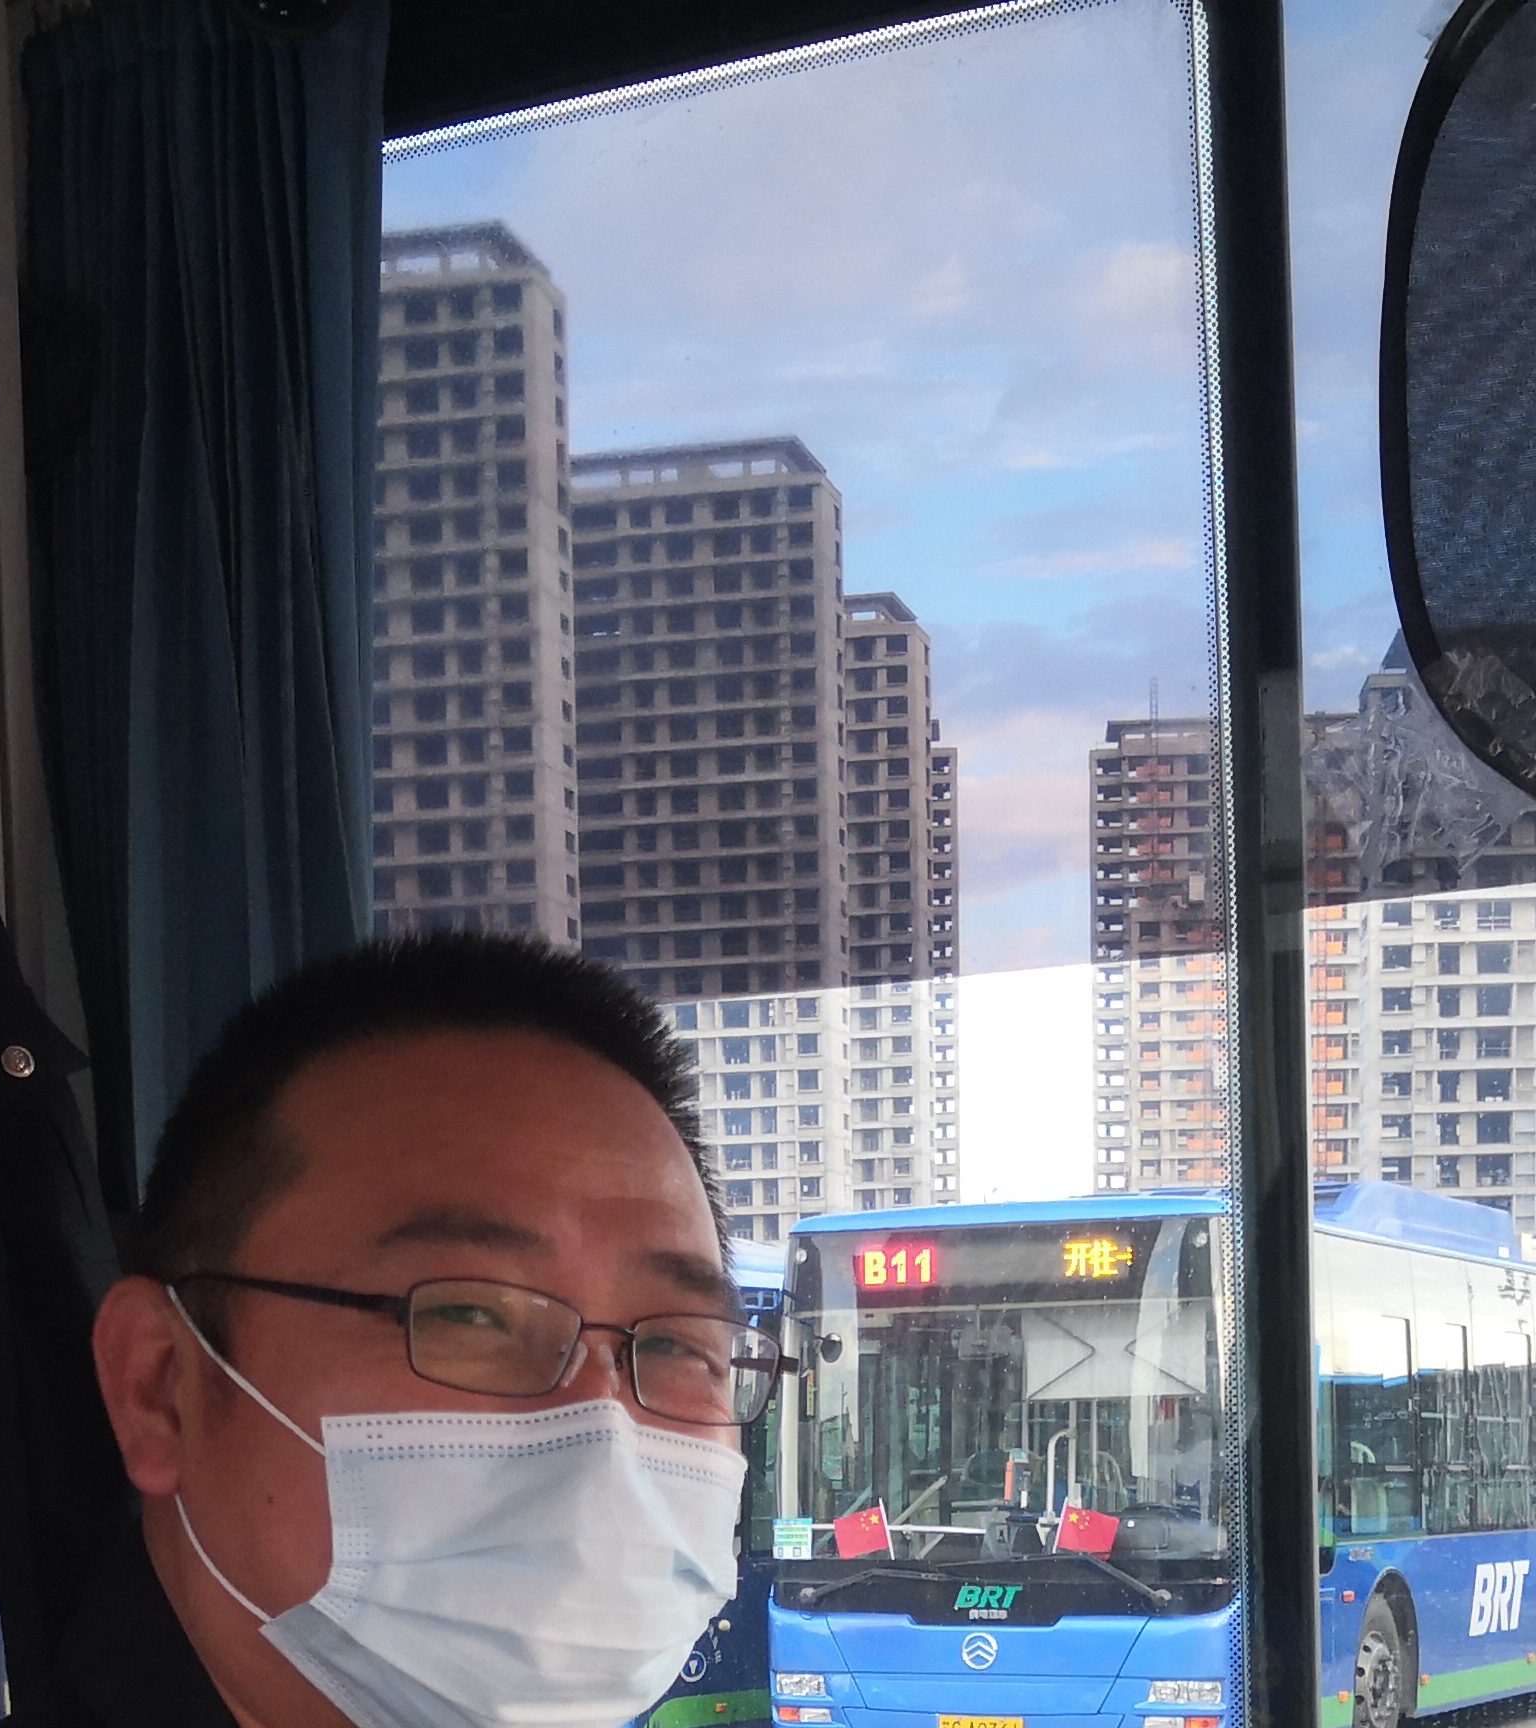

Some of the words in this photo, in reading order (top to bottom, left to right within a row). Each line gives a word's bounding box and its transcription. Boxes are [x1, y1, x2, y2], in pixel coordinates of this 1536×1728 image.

[863, 1248, 932, 1286] B11
[954, 1585, 1024, 1610] BRT
[1468, 1559, 1531, 1638] BRT
